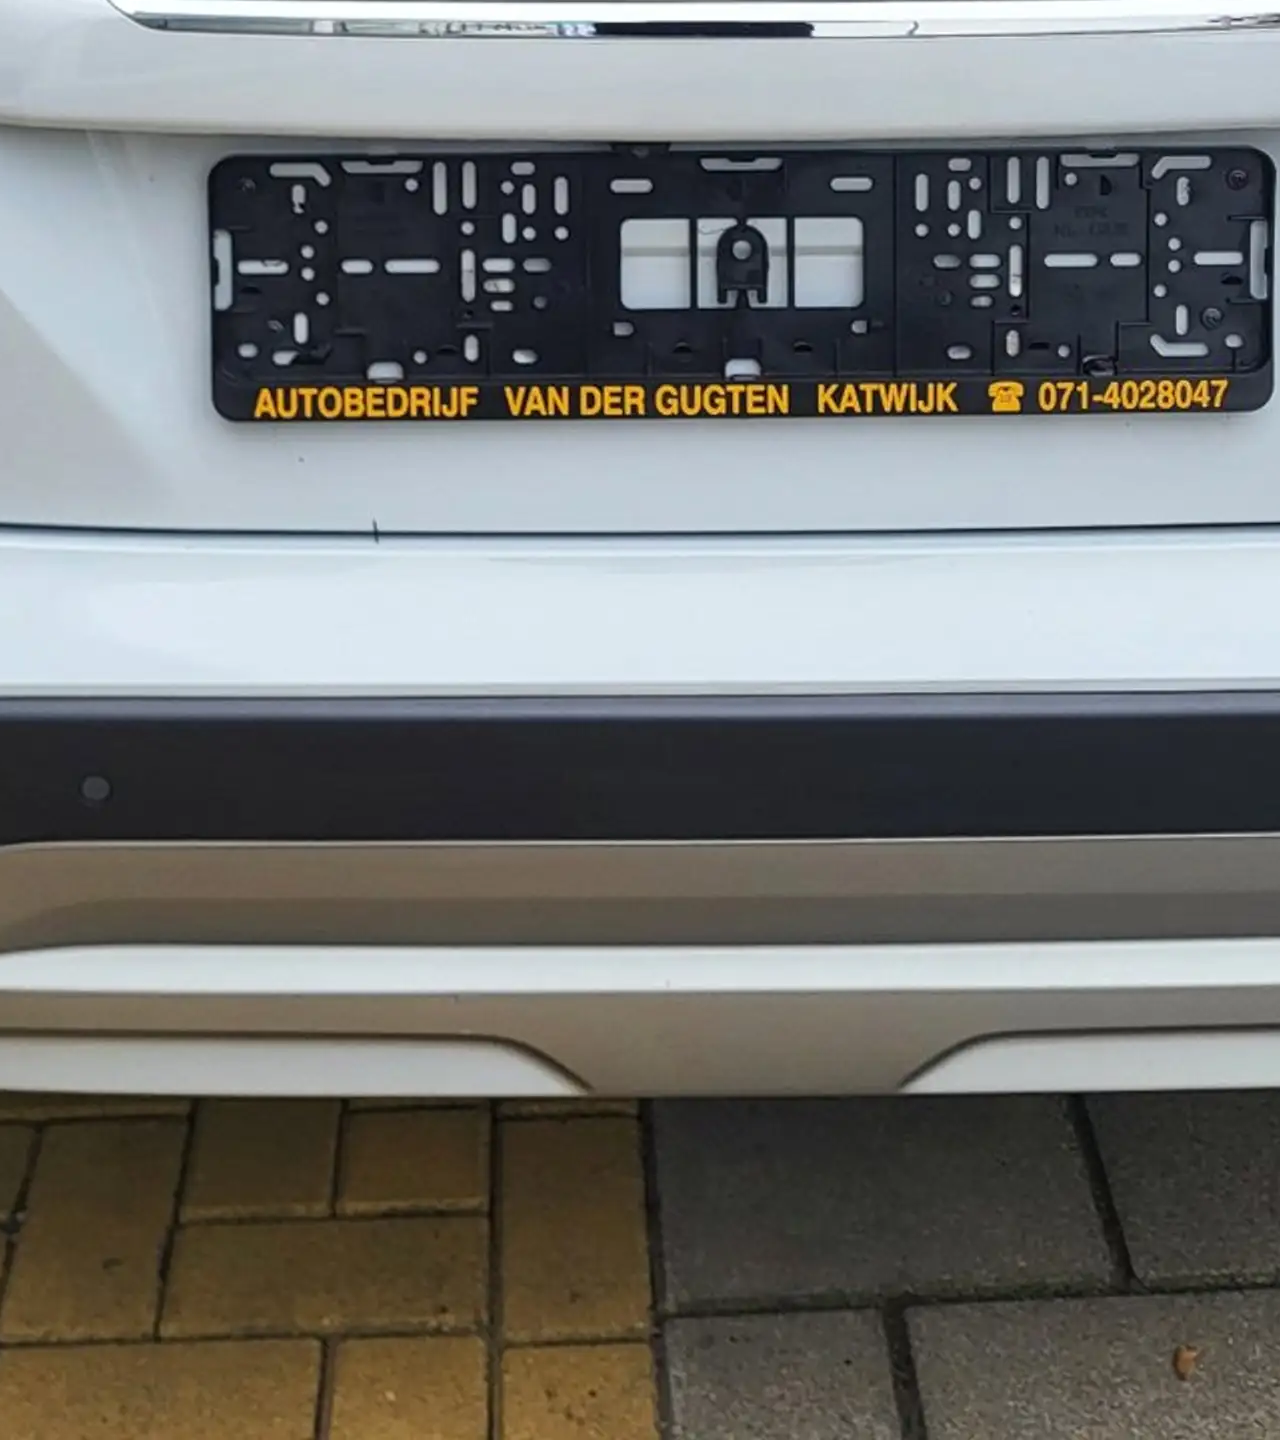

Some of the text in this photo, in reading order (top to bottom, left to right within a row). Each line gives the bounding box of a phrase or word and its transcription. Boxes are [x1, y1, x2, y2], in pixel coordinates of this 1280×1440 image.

[254, 378, 1229, 418] AUTOBEDRIJF VAN DER GUGTEN KATWIJK 071-4028047
